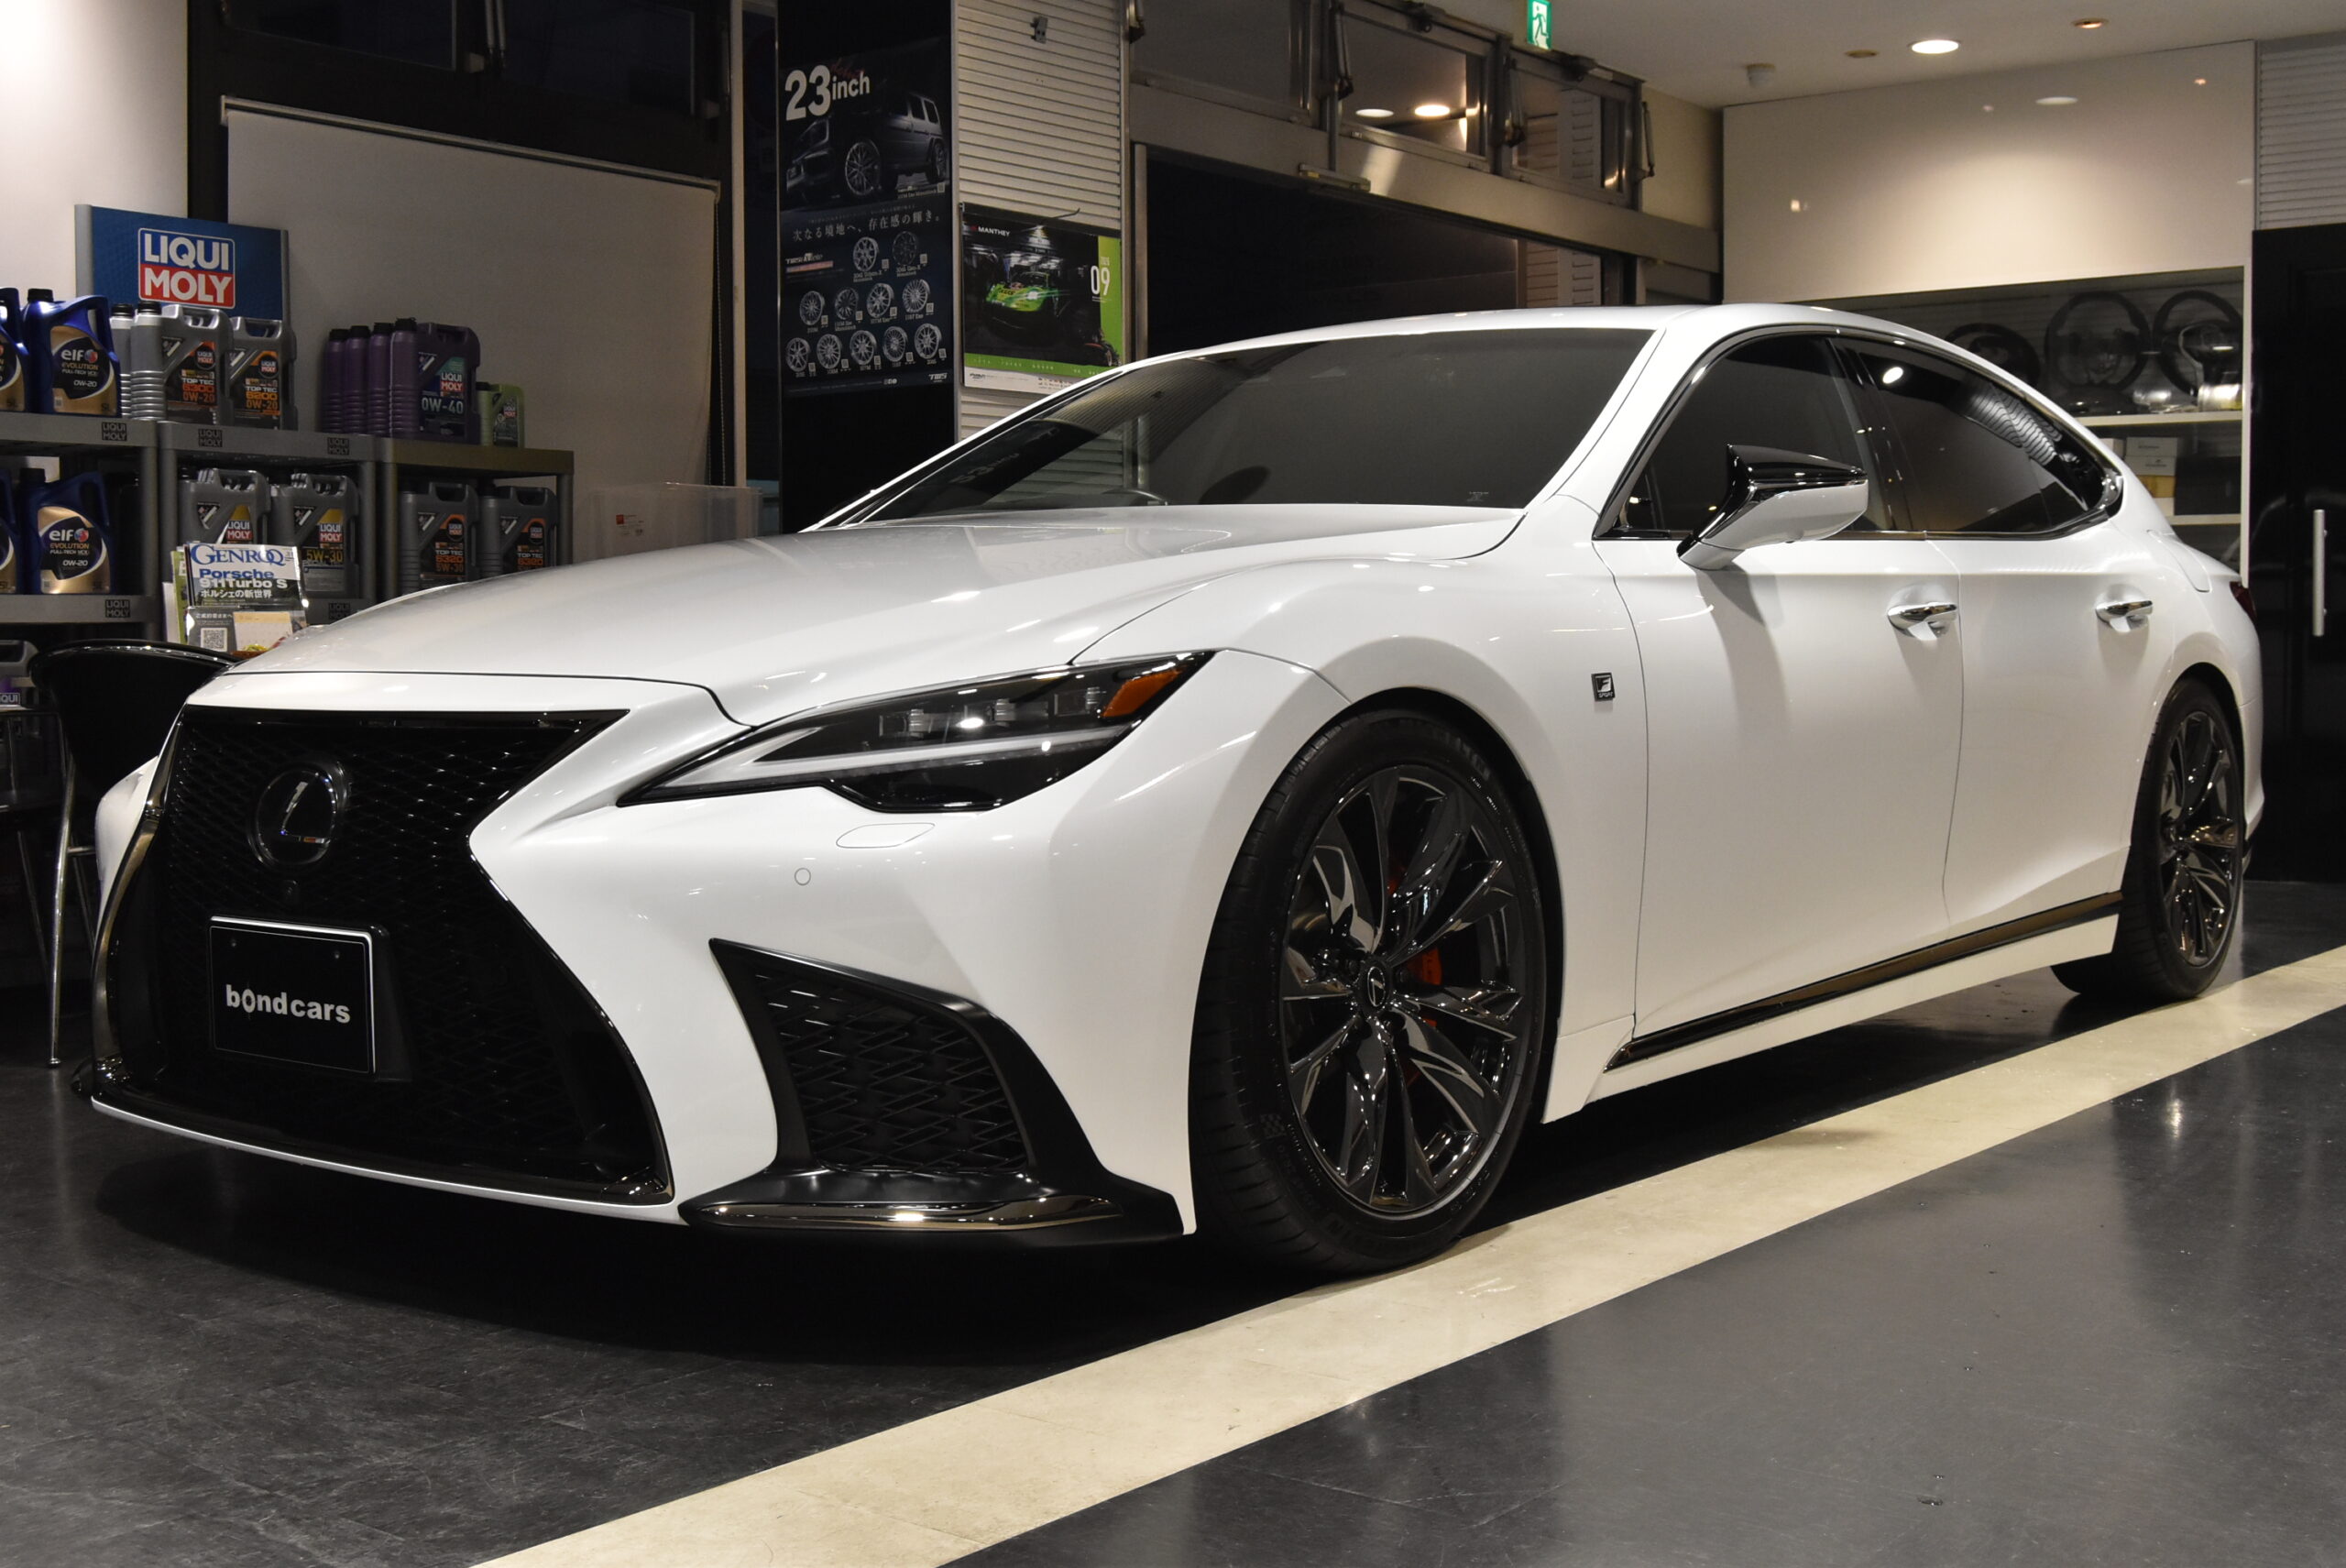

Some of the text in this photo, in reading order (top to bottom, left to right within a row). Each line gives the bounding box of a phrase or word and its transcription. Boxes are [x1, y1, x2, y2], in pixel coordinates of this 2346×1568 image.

[978, 226, 1011, 236] MANTHEY
[144, 233, 229, 269] LIQUI
[145, 267, 233, 303] MOLY
[1091, 265, 1111, 295] 09
[60, 349, 84, 361] elf
[61, 362, 99, 371] EVOLUTION
[441, 372, 463, 382] LIQUI
[441, 381, 464, 391] MOLY
[421, 396, 464, 413] 0W-40
[103, 422, 126, 432] LIQUI
[103, 432, 127, 441] MOLY
[199, 429, 222, 439] LIQUI
[199, 437, 223, 447] MOLY
[228, 521, 250, 530] LIQUI
[320, 523, 341, 532] LIQUI
[49, 529, 74, 542] elf
[227, 531, 251, 540] MOLY
[320, 532, 342, 542] MOLY
[306, 549, 344, 563] 5W-30
[199, 568, 274, 580] Porsche
[277, 578, 288, 589] S
[201, 589, 273, 598] ポルシェの新世界
[106, 599, 129, 609] LIQUI
[106, 609, 130, 618] MOLY
[0, 694, 18, 703] QUI
